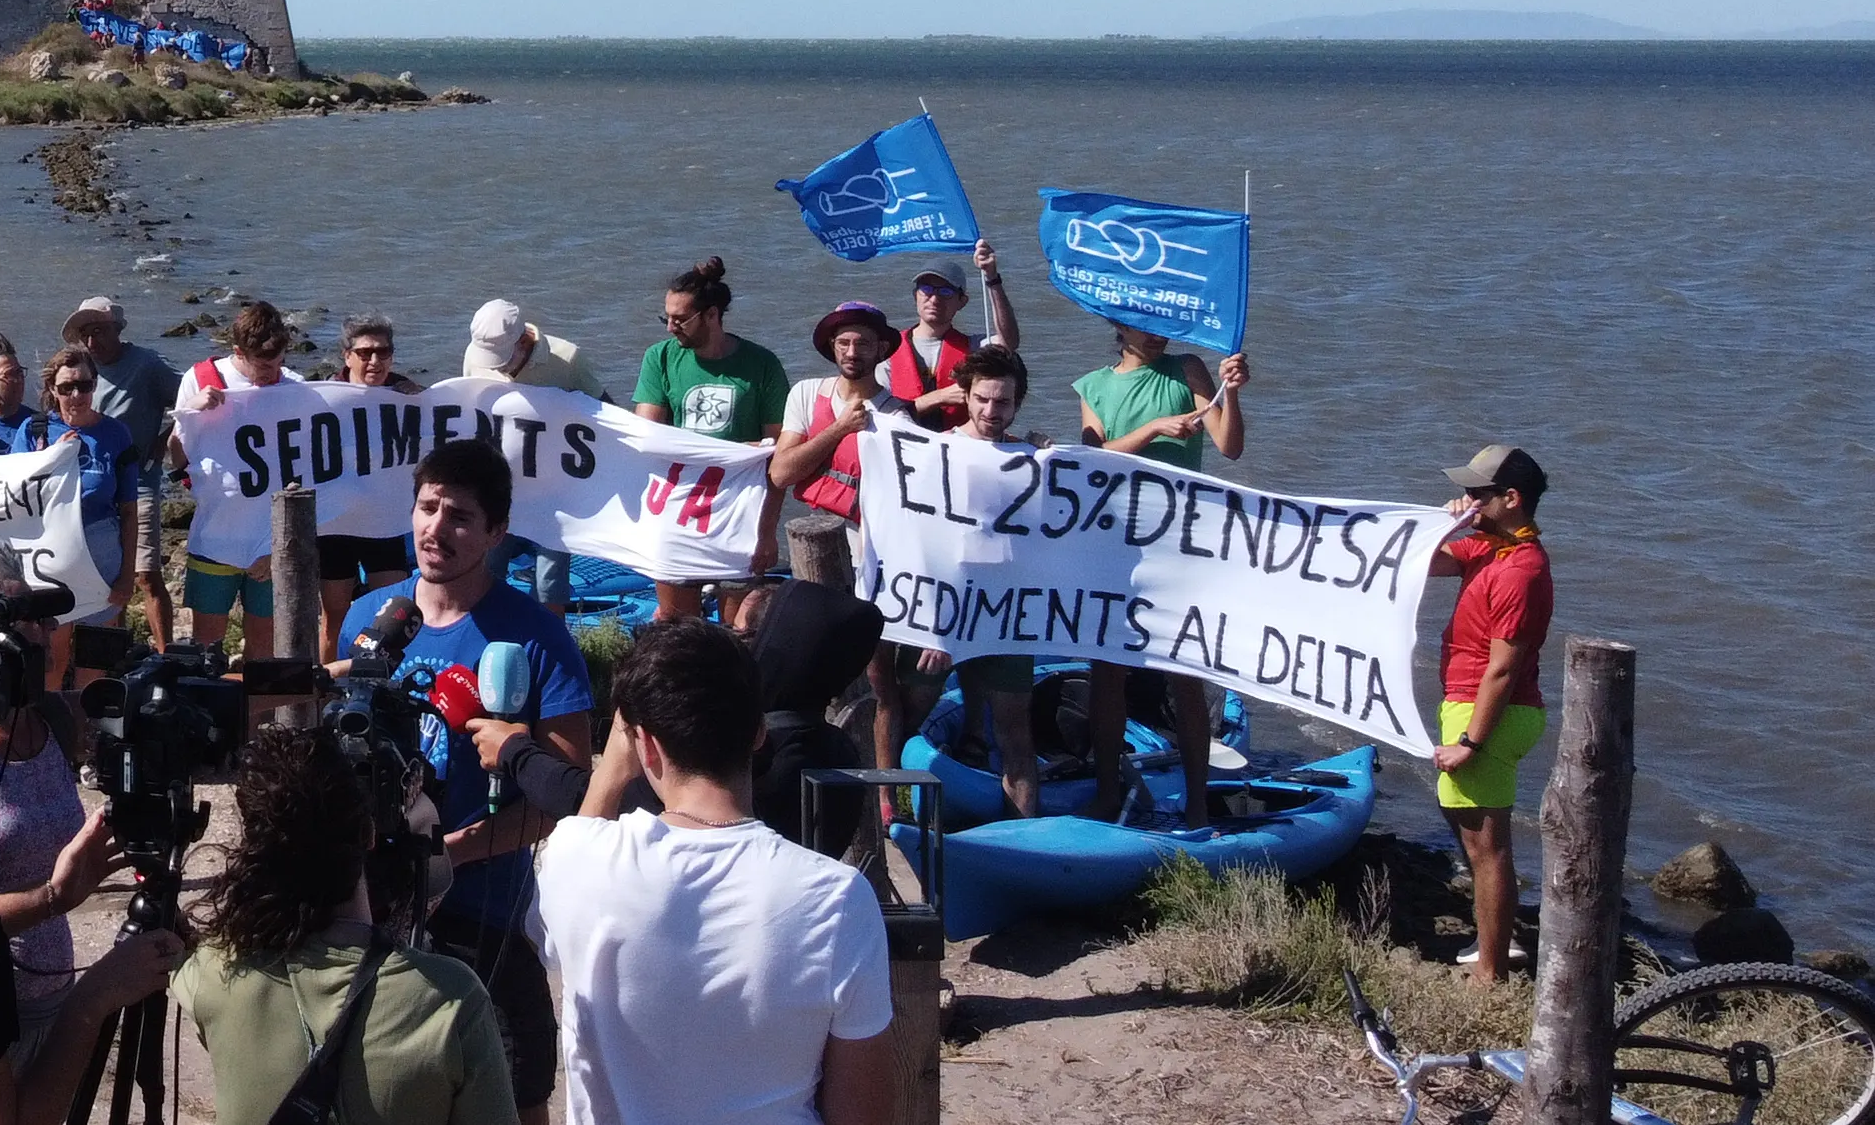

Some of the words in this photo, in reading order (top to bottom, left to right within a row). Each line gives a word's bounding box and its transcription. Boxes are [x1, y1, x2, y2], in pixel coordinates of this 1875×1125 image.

[647, 461, 726, 535] JA
[891, 430, 978, 526] EL
[884, 571, 1152, 652] SEDIMENTS
[1169, 606, 1240, 673] AL
[1256, 624, 1406, 737] DELTA
